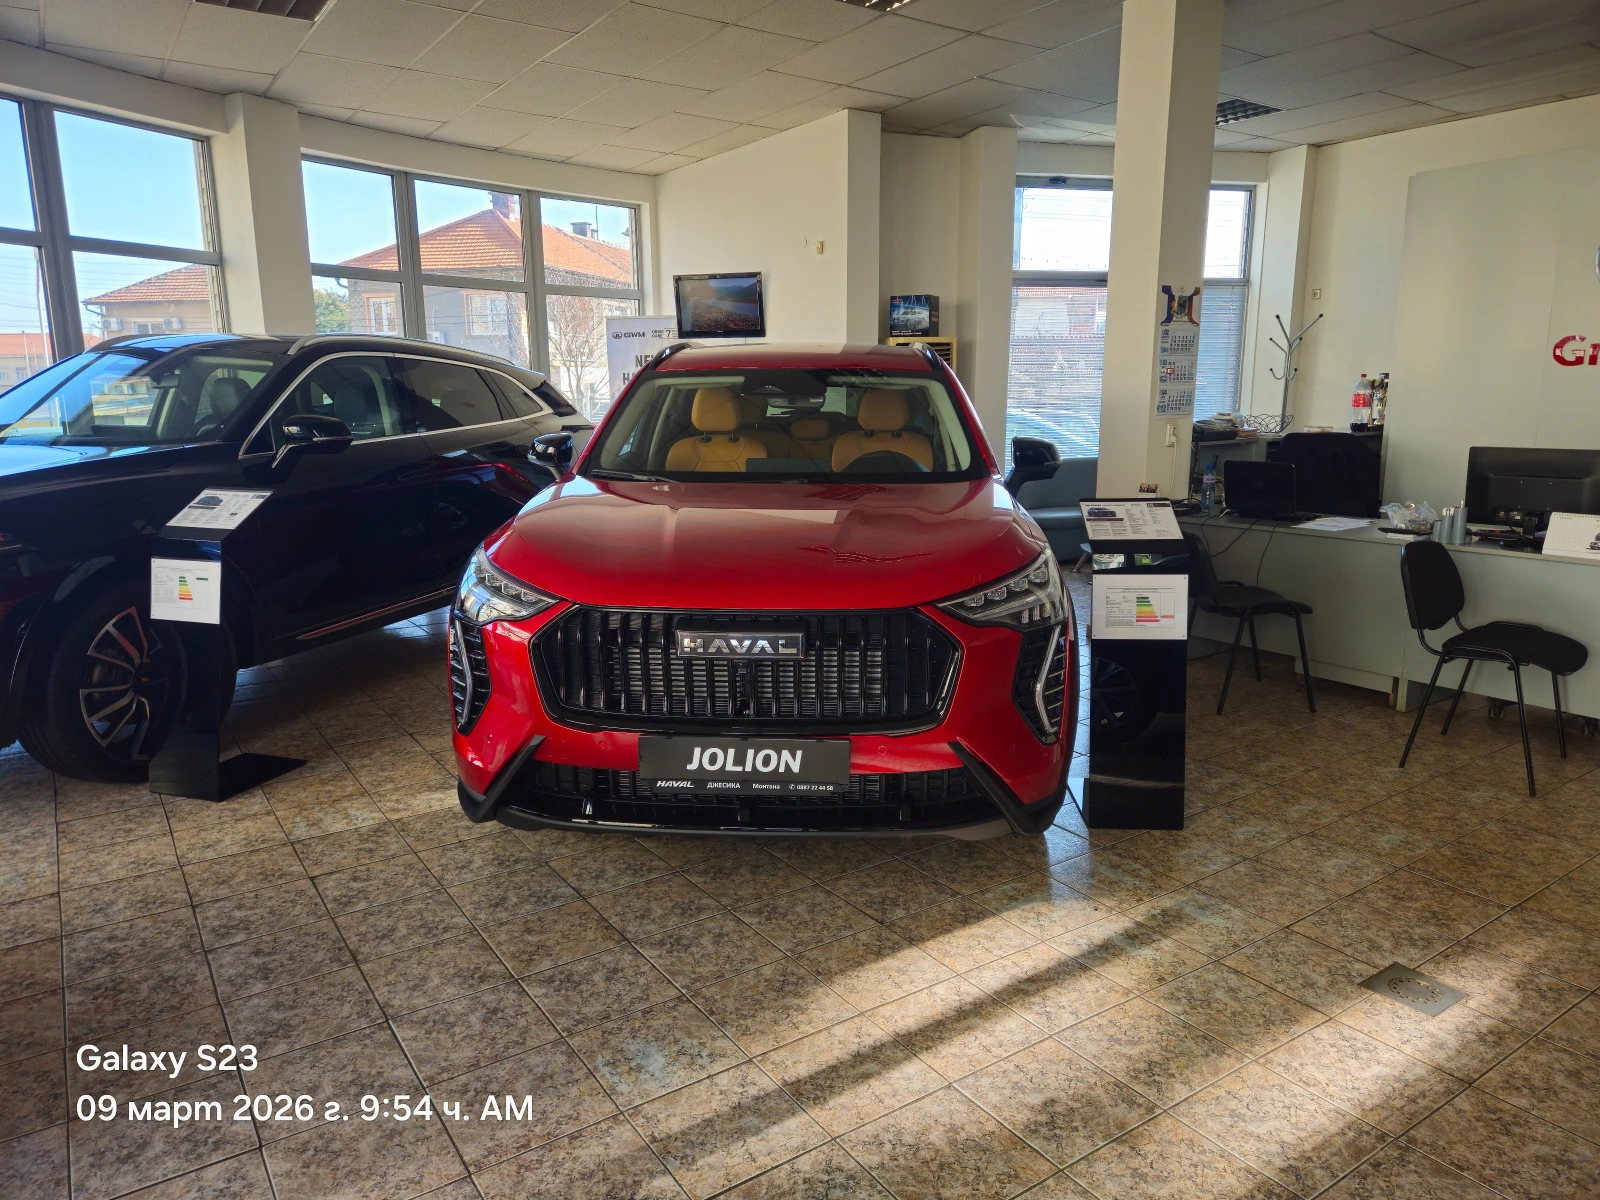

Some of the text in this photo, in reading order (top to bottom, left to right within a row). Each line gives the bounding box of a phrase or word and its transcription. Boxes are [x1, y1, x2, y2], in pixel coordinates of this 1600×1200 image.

[684, 638, 798, 654] HAVAL
[686, 747, 802, 773] JOLION
[656, 780, 695, 788] HAVAL
